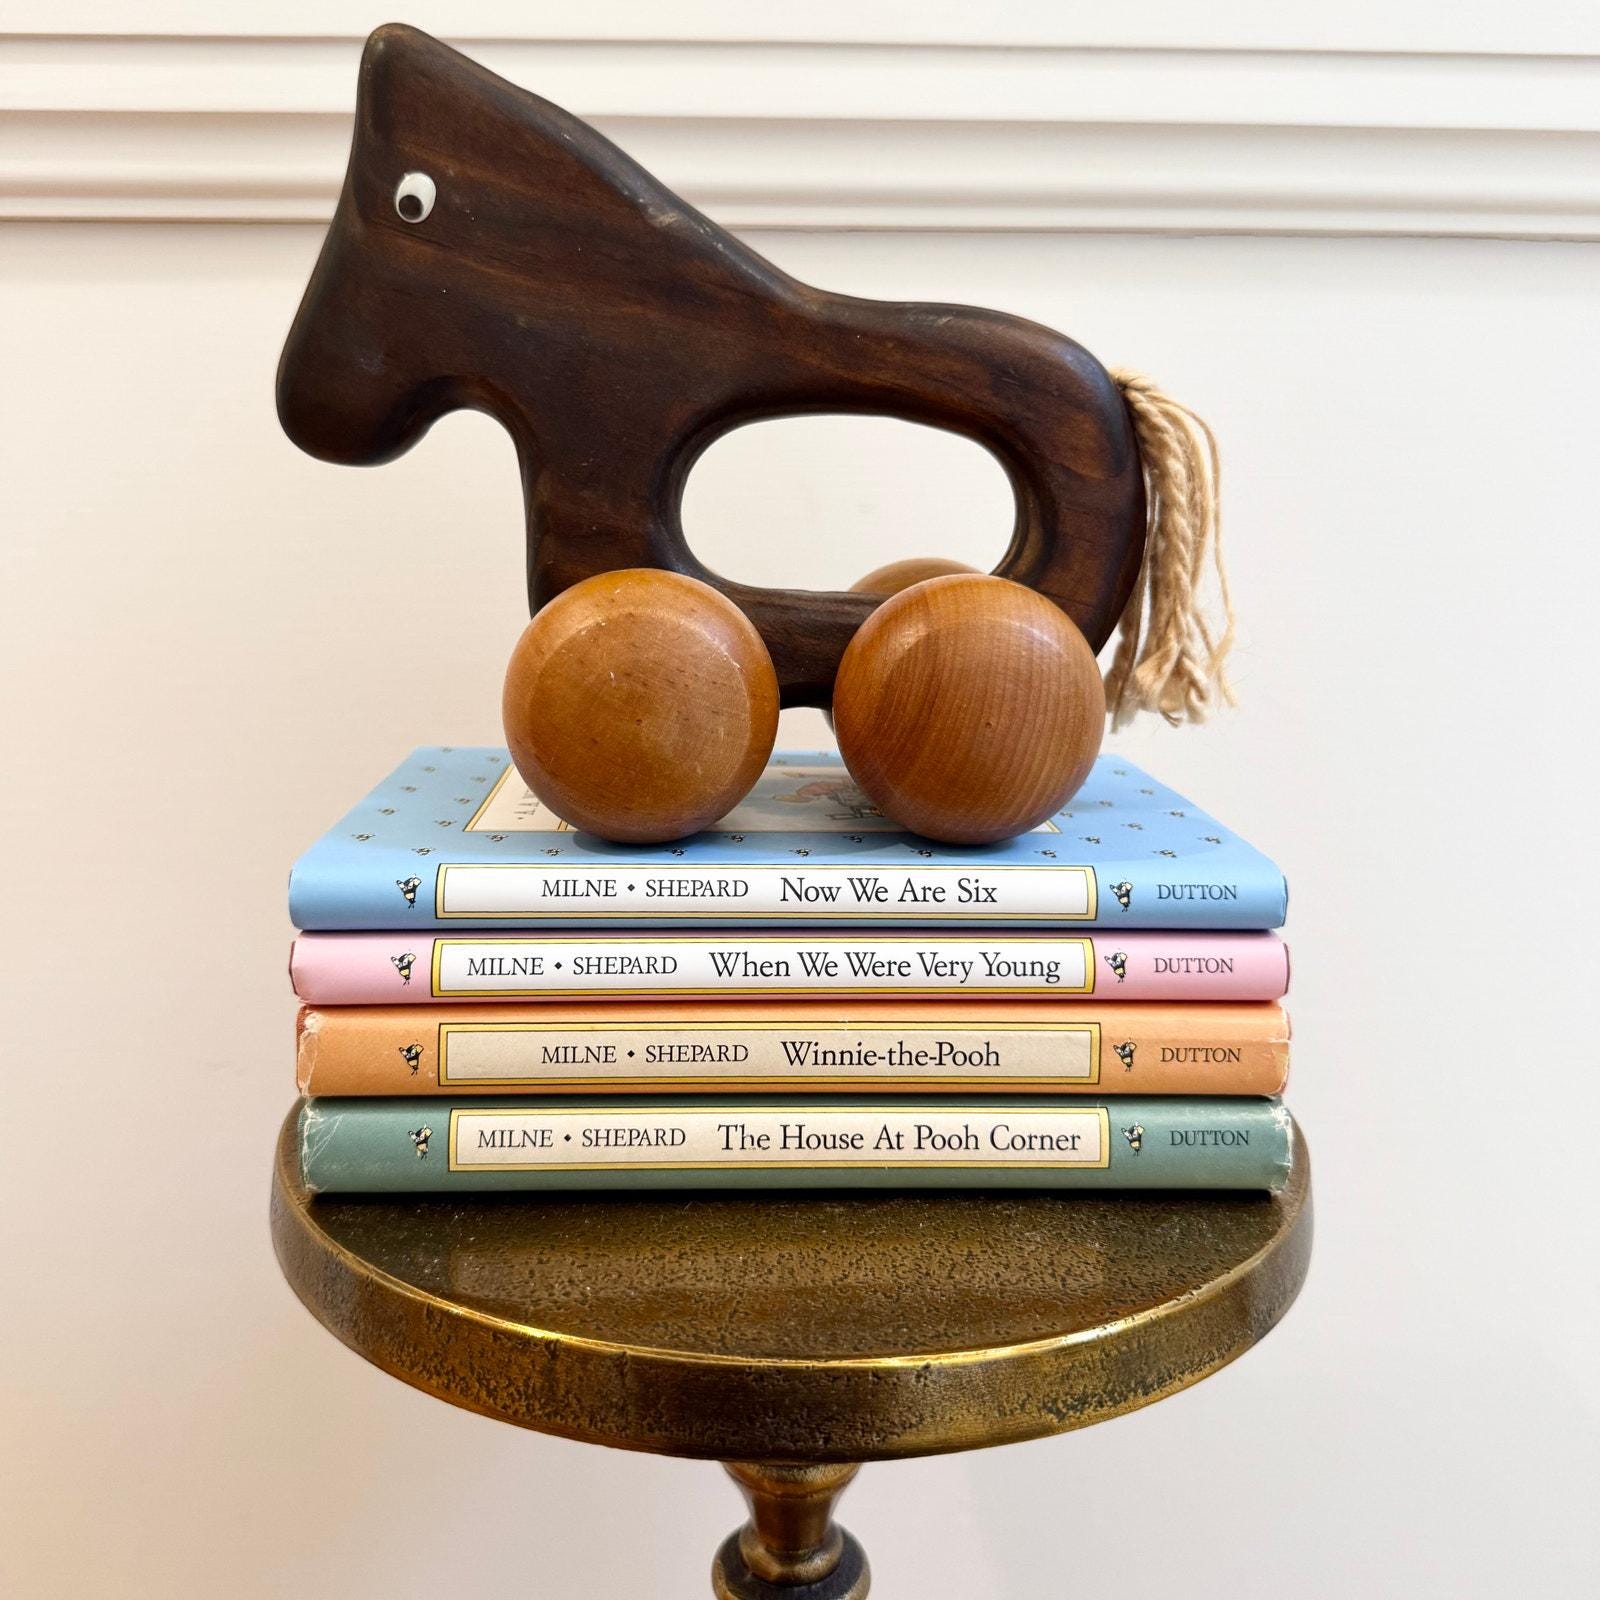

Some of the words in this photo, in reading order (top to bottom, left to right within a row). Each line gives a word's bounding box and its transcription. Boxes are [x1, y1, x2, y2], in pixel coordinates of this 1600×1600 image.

[540, 879, 618, 898] MILNE
[645, 878, 749, 898] SHEPARD
[779, 876, 842, 902] Now
[846, 877, 889, 904] We
[896, 877, 947, 905] Are
[957, 877, 999, 904] Six
[1156, 884, 1238, 902] DUTTON
[466, 956, 545, 977] MILNE
[572, 955, 678, 976] SHEPARD
[707, 950, 792, 979] When
[796, 951, 839, 978] We
[843, 951, 912, 978] Were
[916, 951, 974, 983] Very
[979, 951, 1061, 983] Young
[1153, 957, 1234, 975] DUTTON
[540, 1045, 618, 1065] MILNE
[645, 1044, 750, 1064] SHEPARD
[780, 1039, 1001, 1067] Winnie-the-Pooh
[1160, 1047, 1242, 1064] DUTTON
[477, 1128, 554, 1151] MILNE
[581, 1127, 687, 1148] SHEPARD
[716, 1123, 771, 1153] The
[779, 1123, 865, 1152] House
[872, 1123, 905, 1152] At
[912, 1123, 981, 1152] Pooh
[989, 1123, 1082, 1152] Corner
[1169, 1129, 1250, 1147] DUTTON
